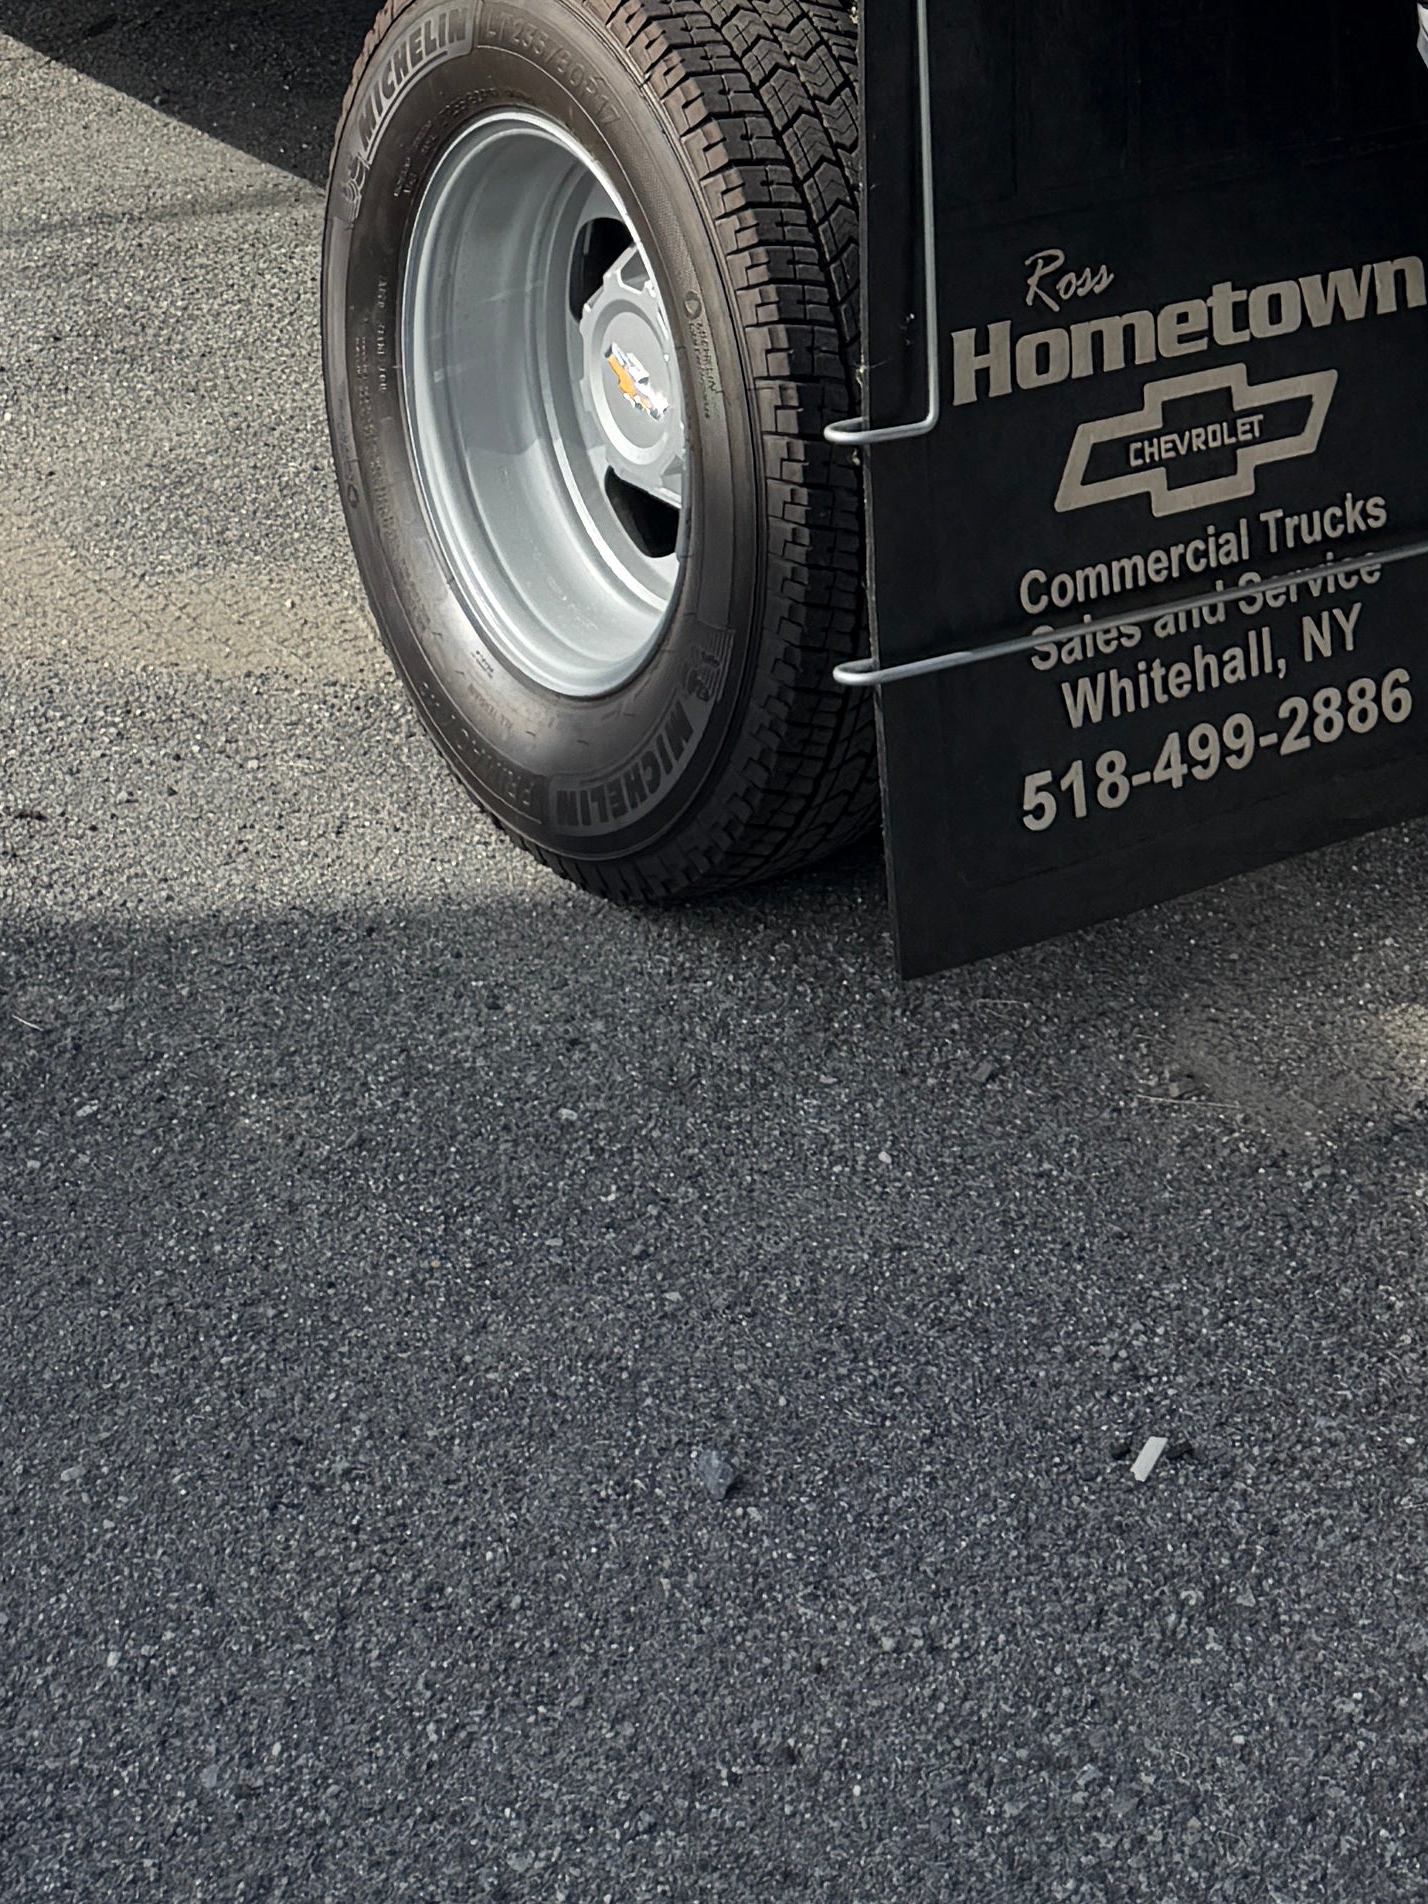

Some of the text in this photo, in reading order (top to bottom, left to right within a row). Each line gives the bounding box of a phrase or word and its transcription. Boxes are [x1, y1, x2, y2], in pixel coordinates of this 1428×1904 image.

[357, 7, 468, 151] MICHELIN
[951, 255, 1427, 406] Hometown
[1024, 248, 1115, 312] Ross
[1129, 413, 1264, 467] CHEVROLET
[1019, 492, 1387, 614] Commercial Trucks
[1061, 601, 1363, 728] Whitehall, NY
[555, 701, 695, 827] MICHELIN
[1022, 667, 1413, 832] 518-499-2886
